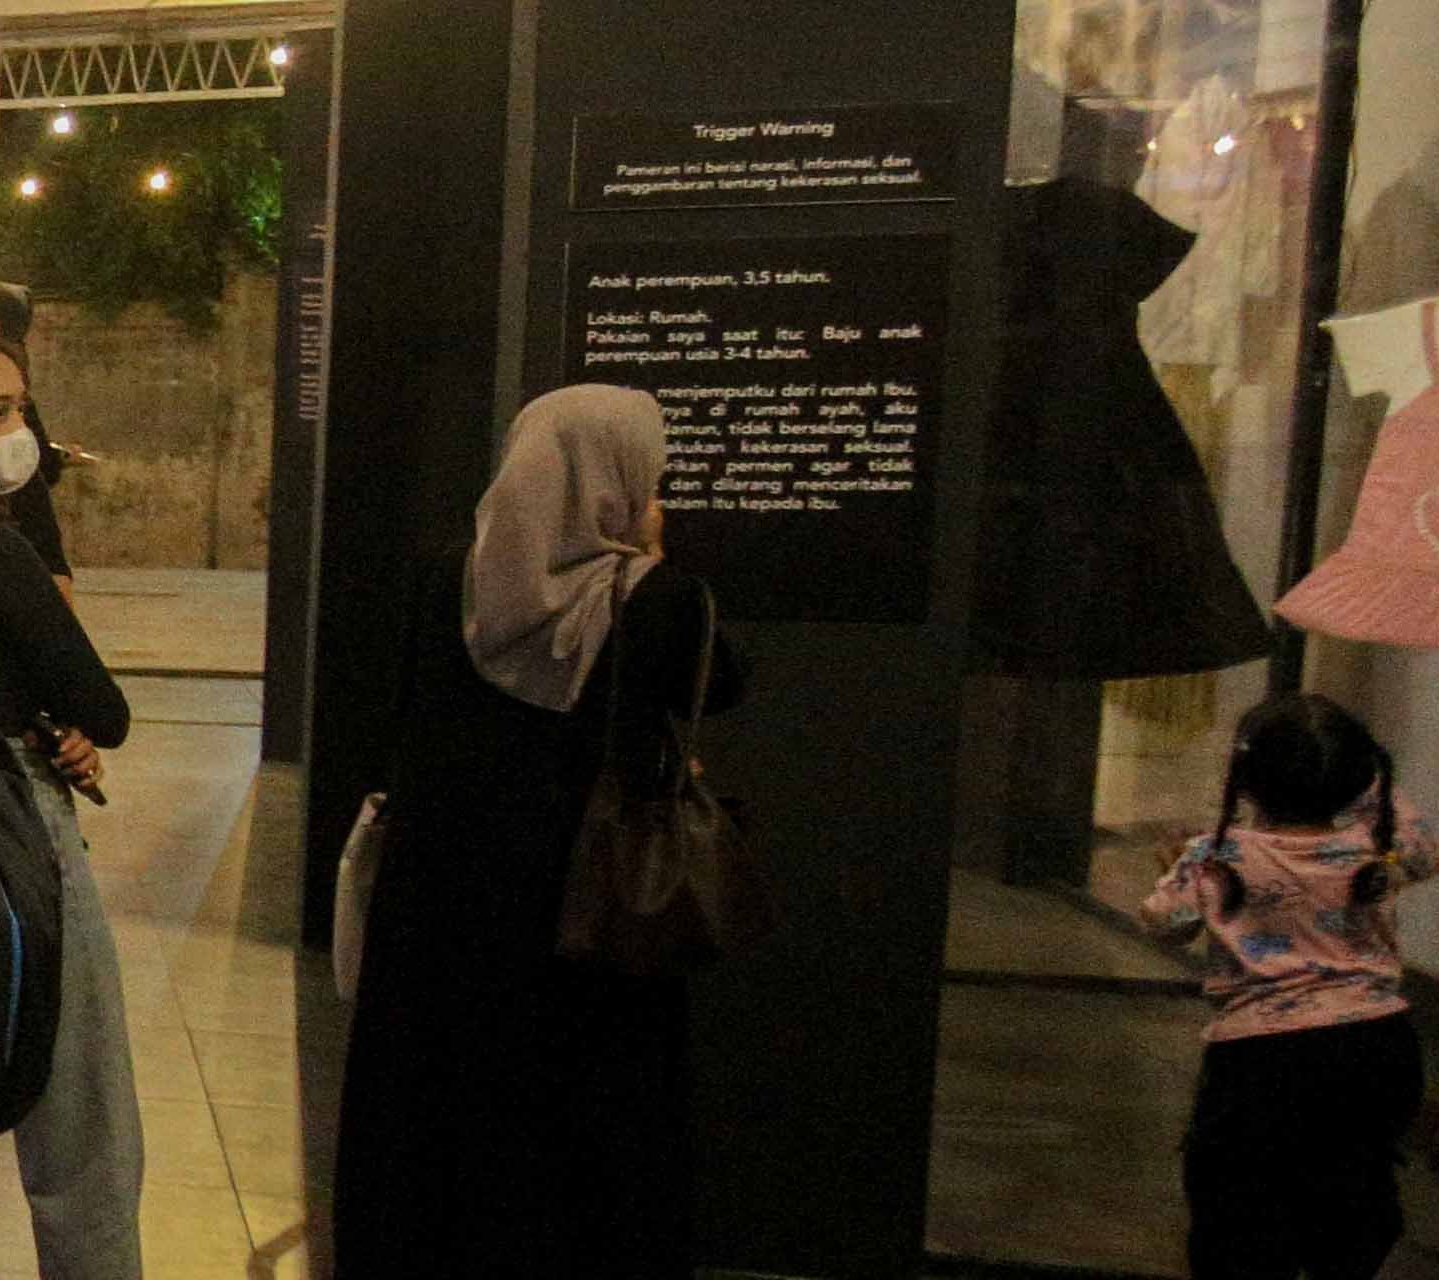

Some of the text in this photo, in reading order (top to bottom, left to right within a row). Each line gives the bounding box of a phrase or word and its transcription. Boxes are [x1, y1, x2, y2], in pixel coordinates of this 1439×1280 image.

[693, 121, 835, 141] Trigger Warning
[589, 275, 632, 288] Anak
[585, 348, 680, 366] perempuan
[686, 348, 719, 360] usia
[724, 347, 751, 360] 3-4
